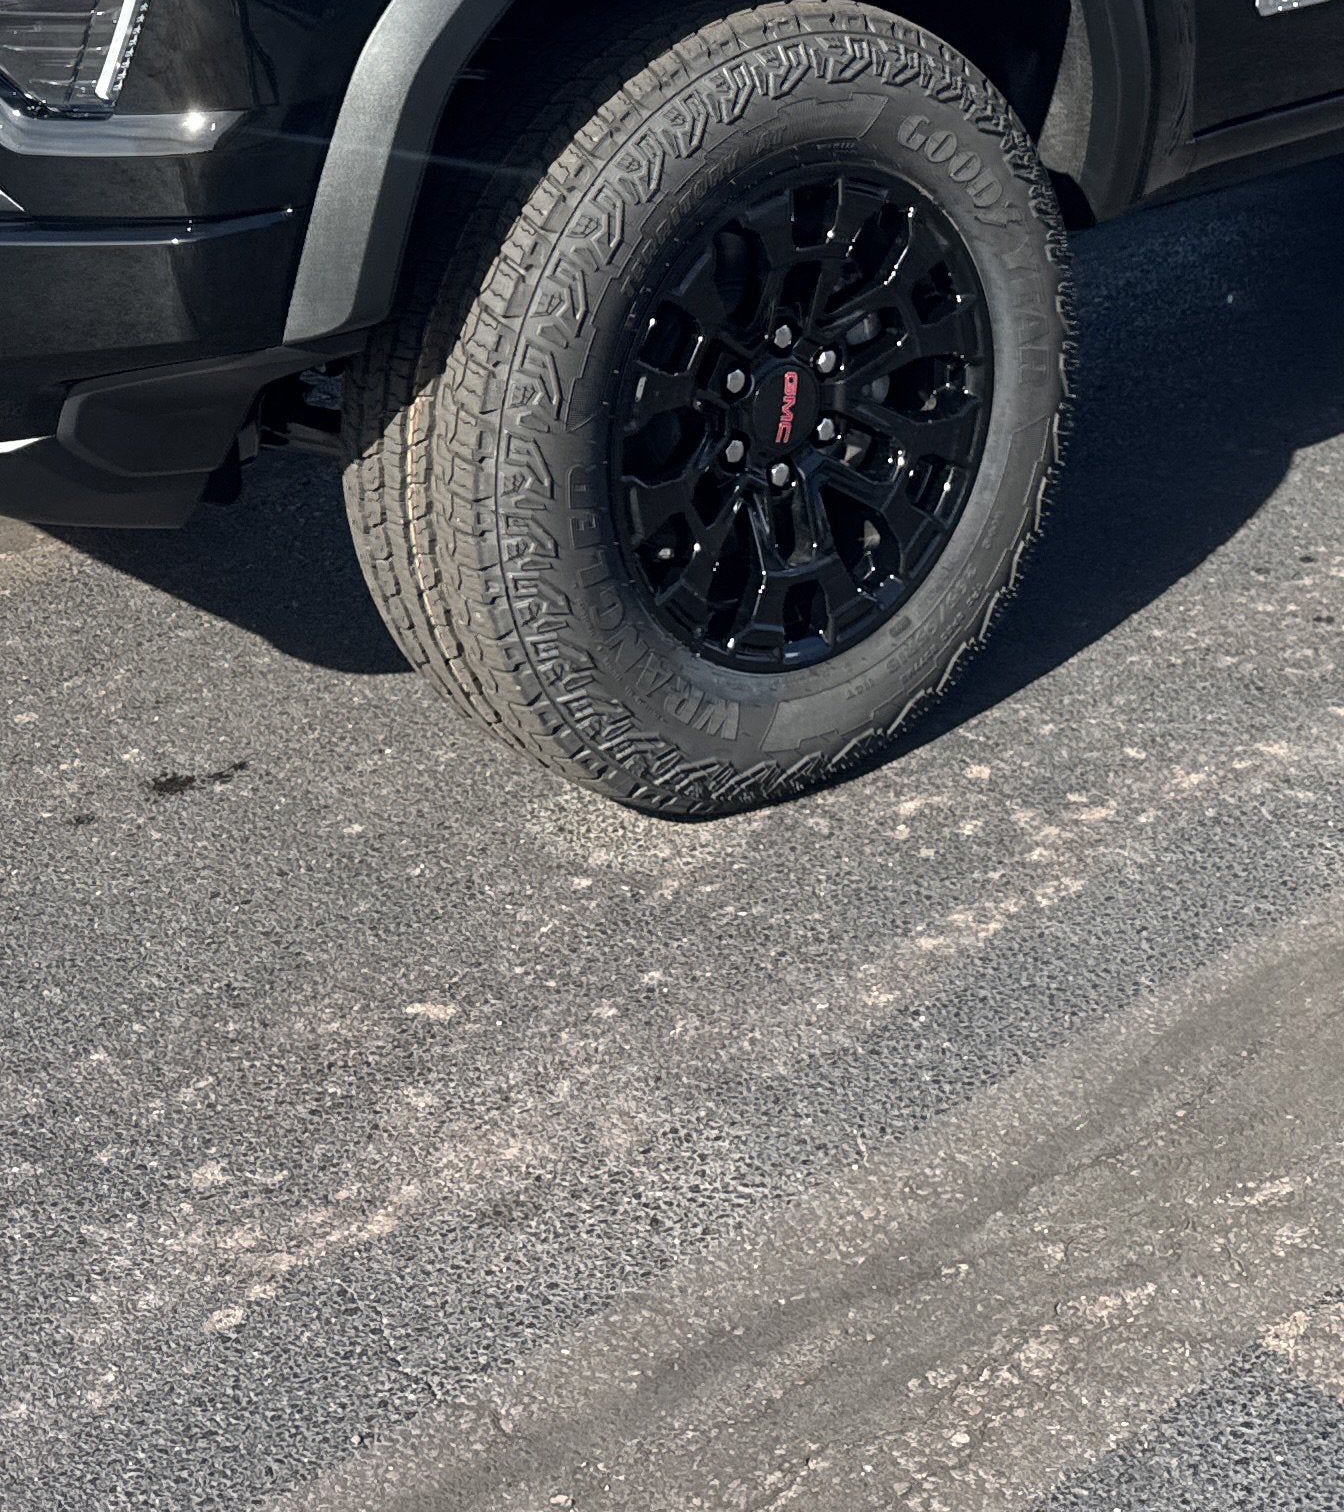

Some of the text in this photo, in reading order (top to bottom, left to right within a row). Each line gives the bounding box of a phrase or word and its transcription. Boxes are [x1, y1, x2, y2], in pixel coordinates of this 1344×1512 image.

[897, 113, 1051, 391] GOODYEAR
[775, 371, 798, 443] GMC
[566, 463, 742, 741] WRANGLER
